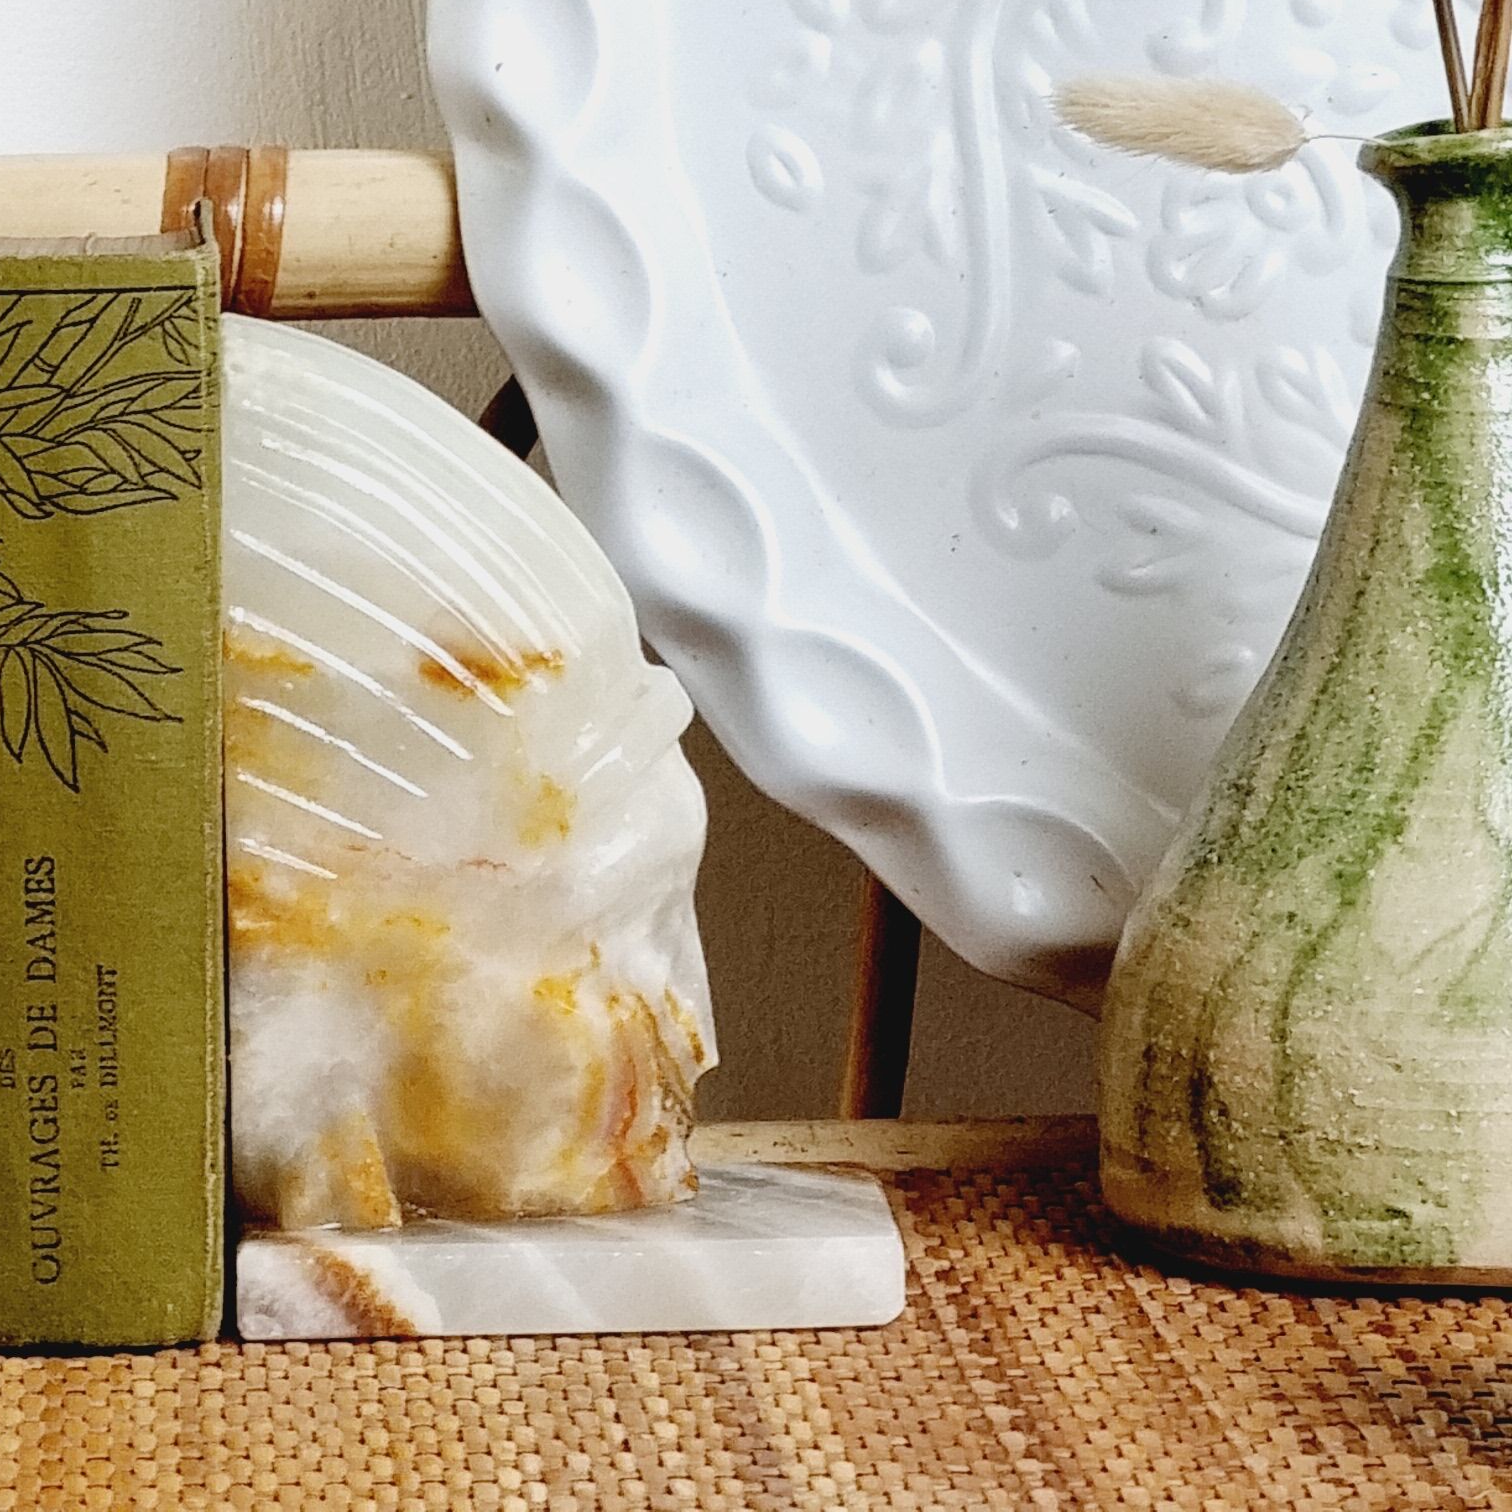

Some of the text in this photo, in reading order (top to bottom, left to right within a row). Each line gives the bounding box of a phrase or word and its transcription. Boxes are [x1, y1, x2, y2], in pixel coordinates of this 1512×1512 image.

[23, 855, 63, 1286] OUVRAGES DE DAMES
[69, 1048, 88, 1092] PAR
[96, 964, 120, 1089] DILLMONT
